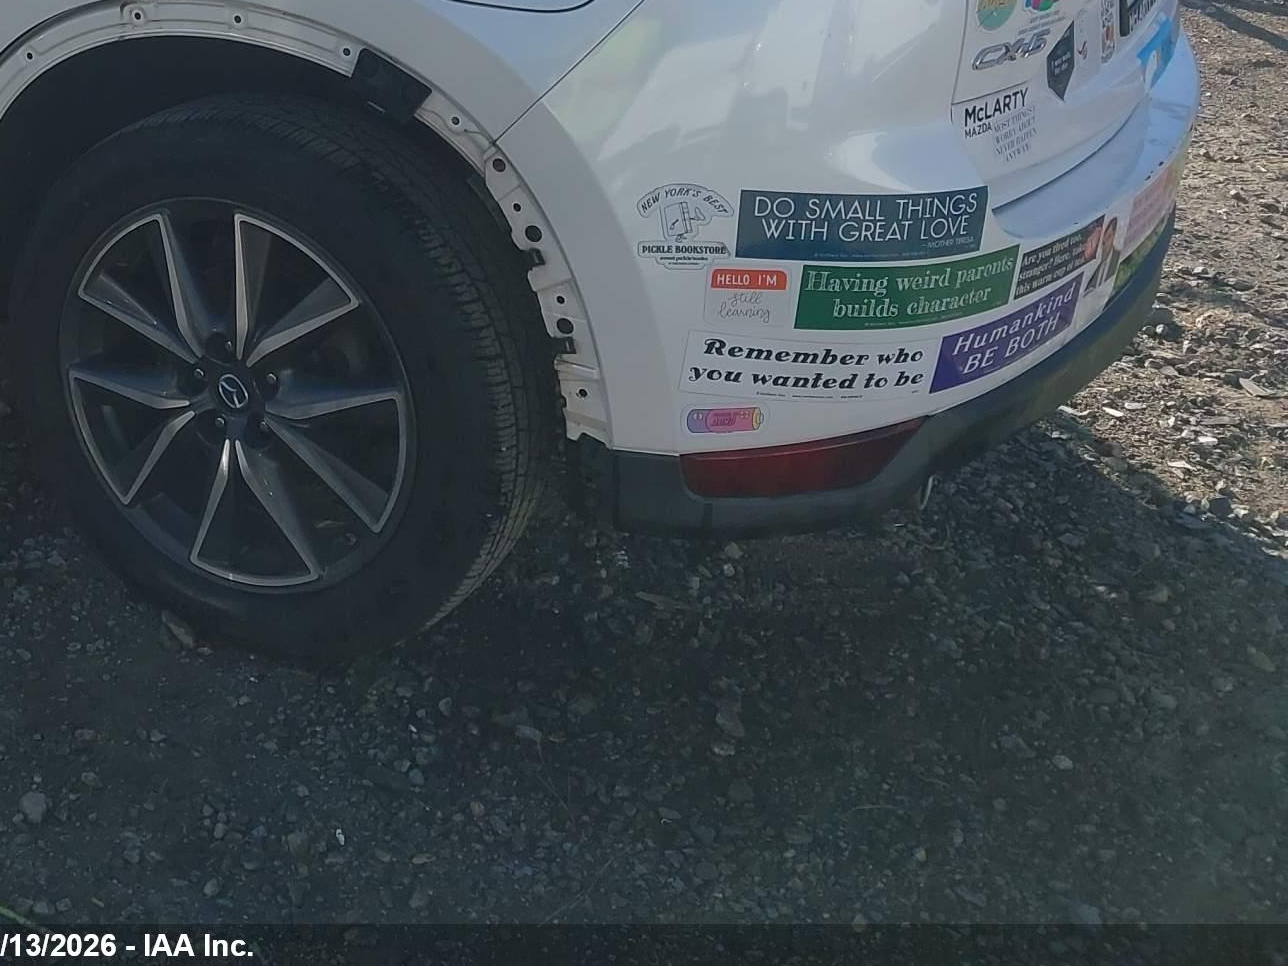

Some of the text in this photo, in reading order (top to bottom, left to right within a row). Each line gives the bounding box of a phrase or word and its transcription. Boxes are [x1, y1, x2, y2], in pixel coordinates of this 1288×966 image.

[964, 87, 1029, 127] McLARTY
[964, 122, 992, 138] MAZDA
[641, 187, 729, 214] NEW YORK'S BEST
[754, 192, 977, 221] DO SMALL THINGS
[762, 214, 970, 242] WITH GREAT LOVE
[642, 245, 727, 255] PICKLE BOOKSTORE
[1024, 255, 1037, 266] Are
[1037, 248, 1052, 264] you
[716, 273, 777, 286] HELLO I'M
[805, 257, 1014, 298] Having weird parents
[1016, 282, 1030, 296] this
[718, 299, 771, 324] learning
[728, 291, 762, 307] still
[833, 286, 991, 318] builds character
[952, 281, 1074, 356] Humankind
[704, 338, 923, 366] Remember who
[963, 314, 1060, 375] BE BOTH
[688, 366, 924, 390] you wanted to be
